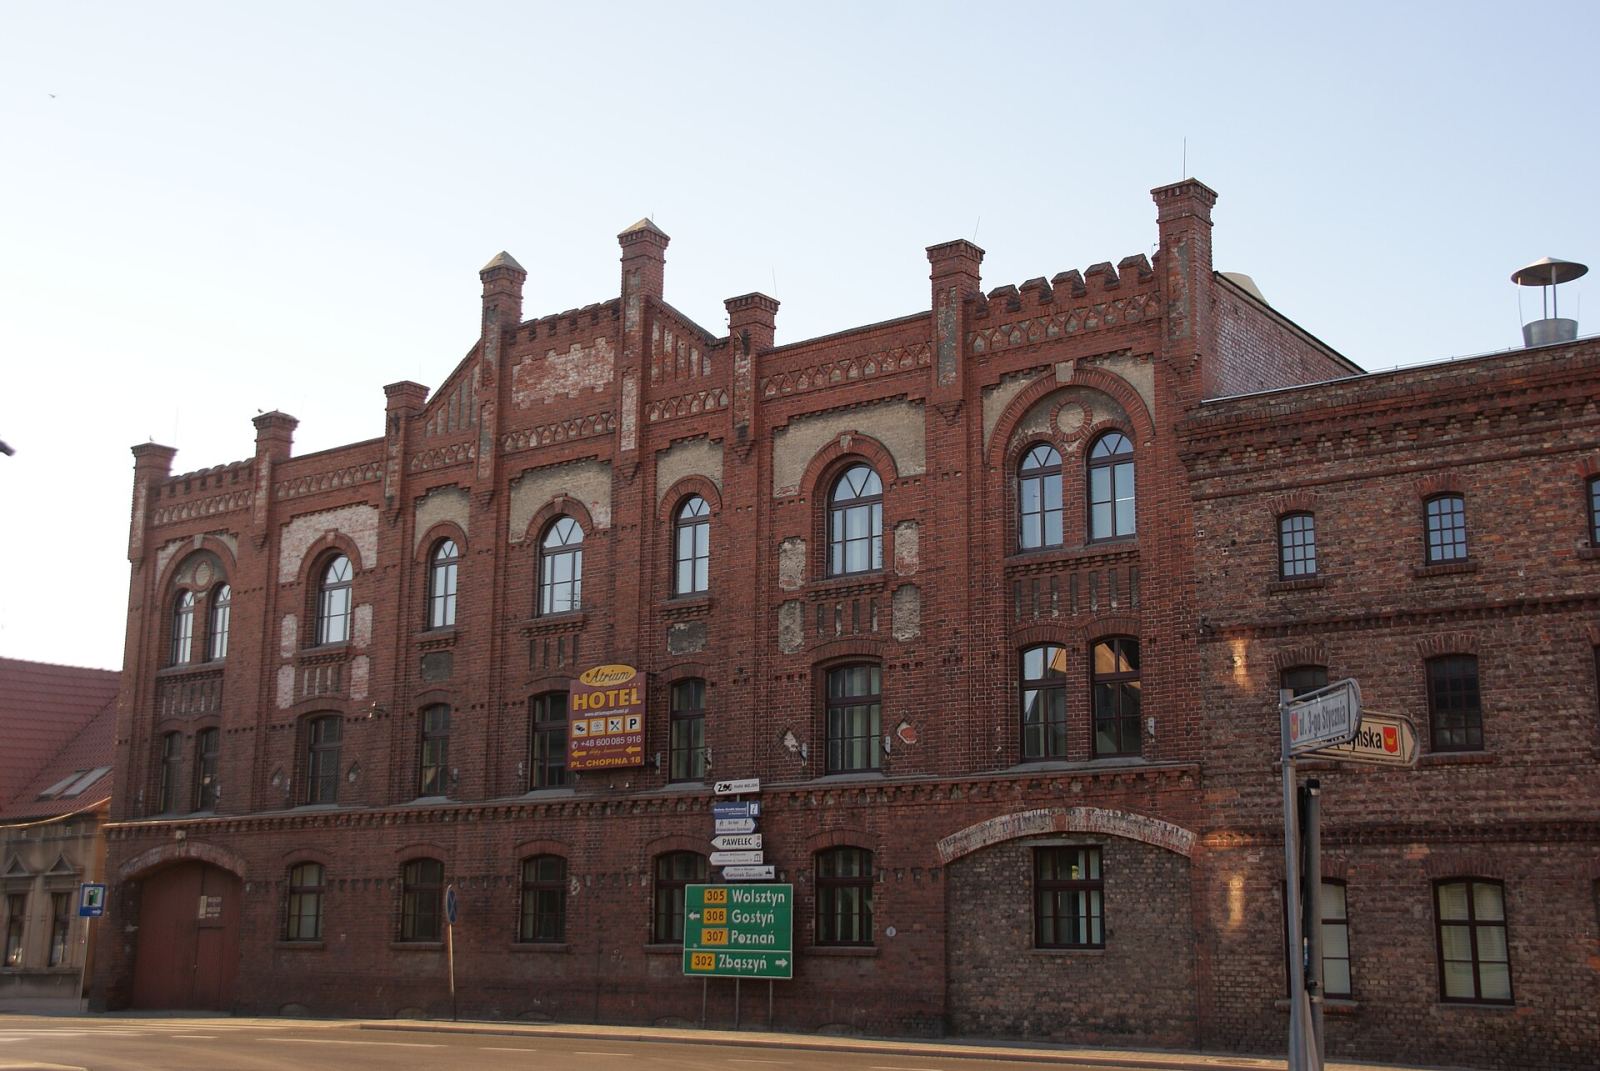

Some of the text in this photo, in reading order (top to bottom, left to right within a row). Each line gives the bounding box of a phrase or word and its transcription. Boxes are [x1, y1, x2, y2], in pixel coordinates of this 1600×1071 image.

[586, 668, 631, 683] Atrium
[573, 688, 641, 711] HOTEL
[1308, 710, 1321, 738] 3-go
[1322, 700, 1346, 735] Stycznia
[586, 757, 628, 767] CHOPINA
[722, 837, 752, 846] PAWELEC
[707, 889, 785, 907] 305 Wolsztyn
[706, 909, 775, 927] 308 Gostyń
[706, 930, 775, 944] 307 Poznań
[695, 954, 767, 973] 302 Zbąszyń
